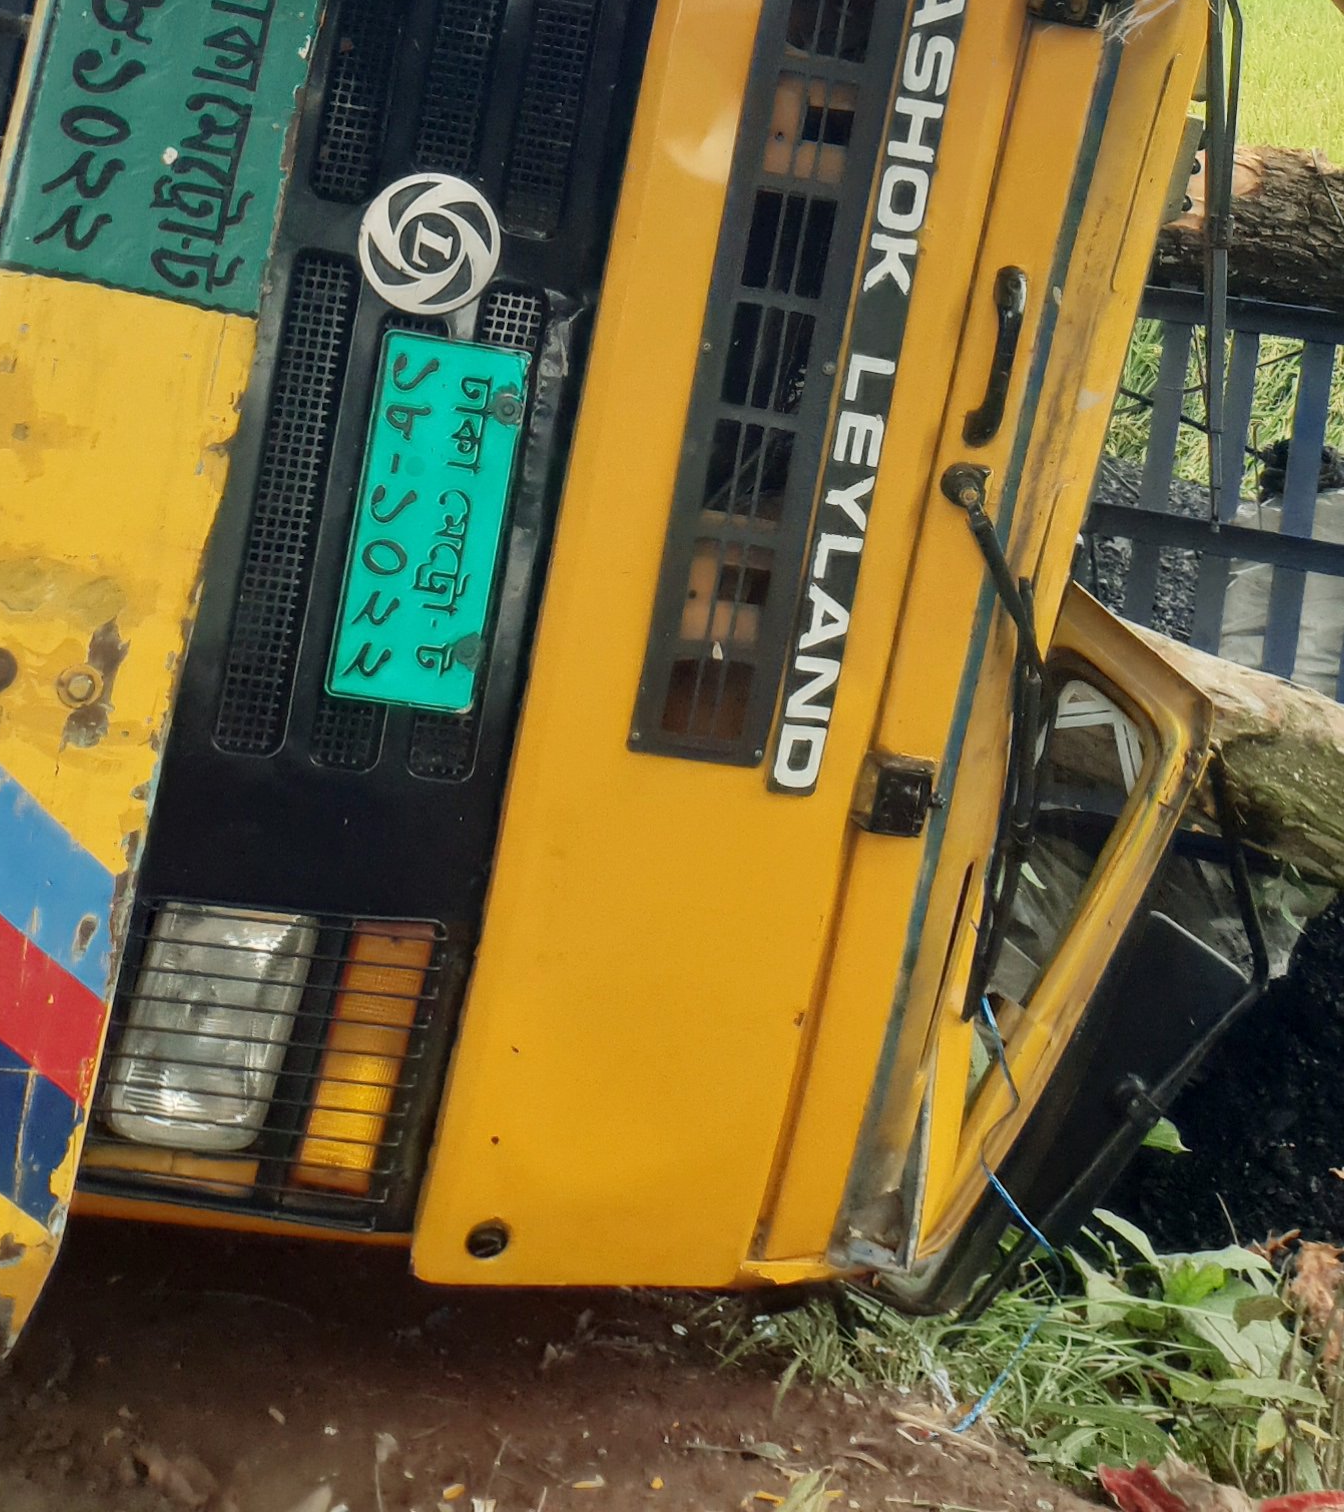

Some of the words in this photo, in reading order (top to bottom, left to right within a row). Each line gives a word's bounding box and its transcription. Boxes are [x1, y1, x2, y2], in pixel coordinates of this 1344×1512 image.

[412, 221, 453, 268] L
[339, 352, 441, 677] ১৮-১০২২
[447, 376, 494, 475] ঢাকা
[774, 352, 896, 790] LEYLAND
